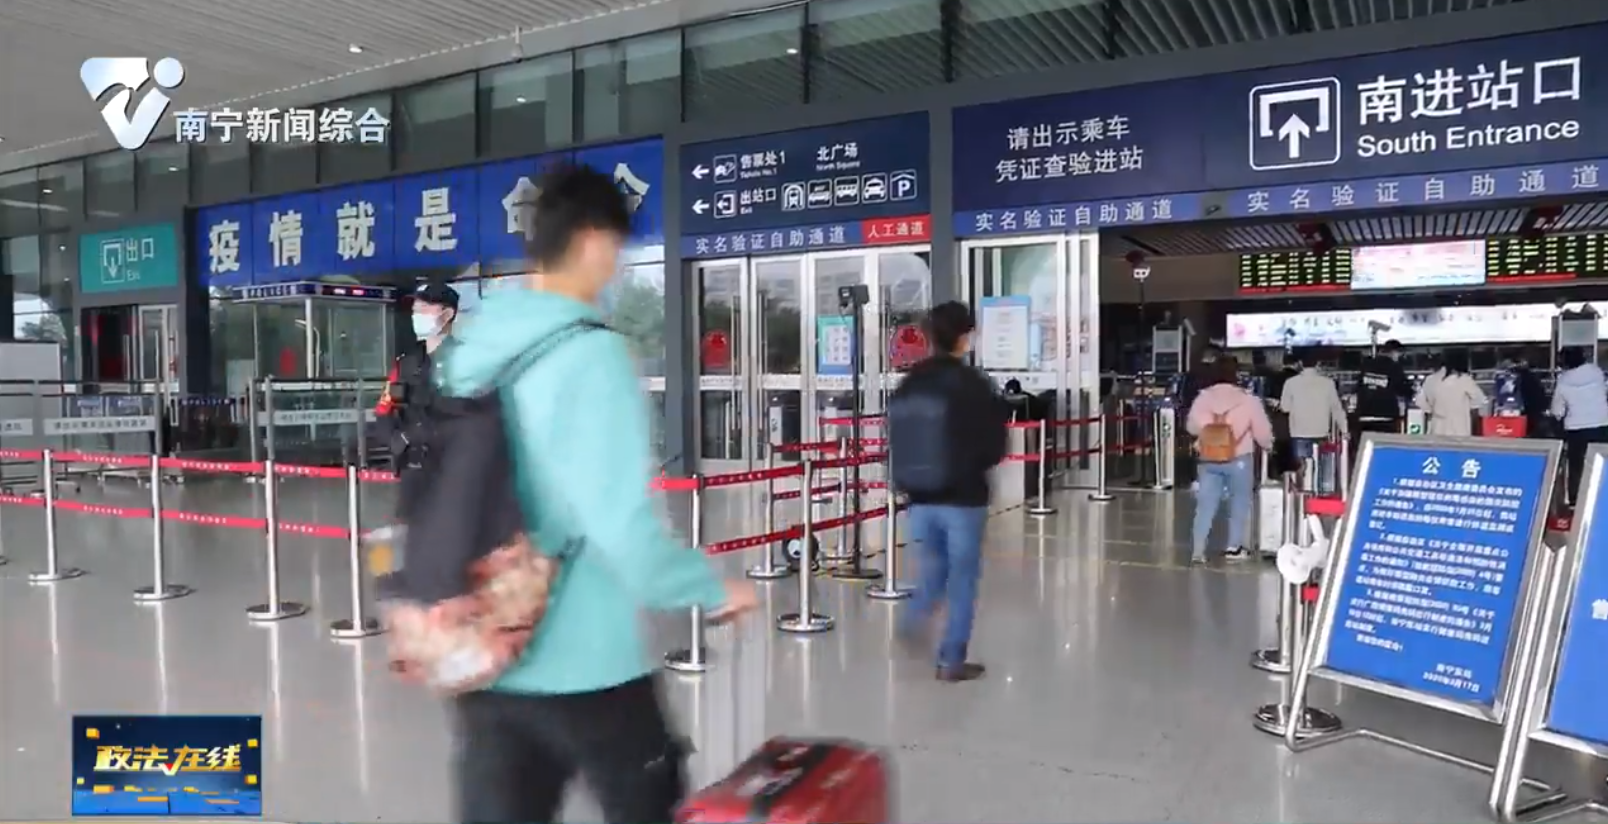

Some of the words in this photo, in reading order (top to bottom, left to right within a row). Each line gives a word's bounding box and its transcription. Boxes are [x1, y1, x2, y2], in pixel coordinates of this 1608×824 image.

[1358, 57, 1581, 125] 南进站口
[1007, 115, 1130, 151] 请出示乘车
[1358, 131, 1436, 157] South
[1446, 120, 1579, 149] Entrance
[817, 142, 858, 161] 北广场
[996, 145, 1143, 183] 凭证查验进站
[740, 187, 777, 205] 出站口
[1248, 165, 1599, 213] 实名验证自助通道
[868, 220, 924, 238] 人工通道
[976, 199, 1172, 231] 实名验证自助通道
[126, 238, 154, 261] 出口
[696, 225, 846, 253] 实名验证自助通道
[1422, 457, 1481, 478] 公告
